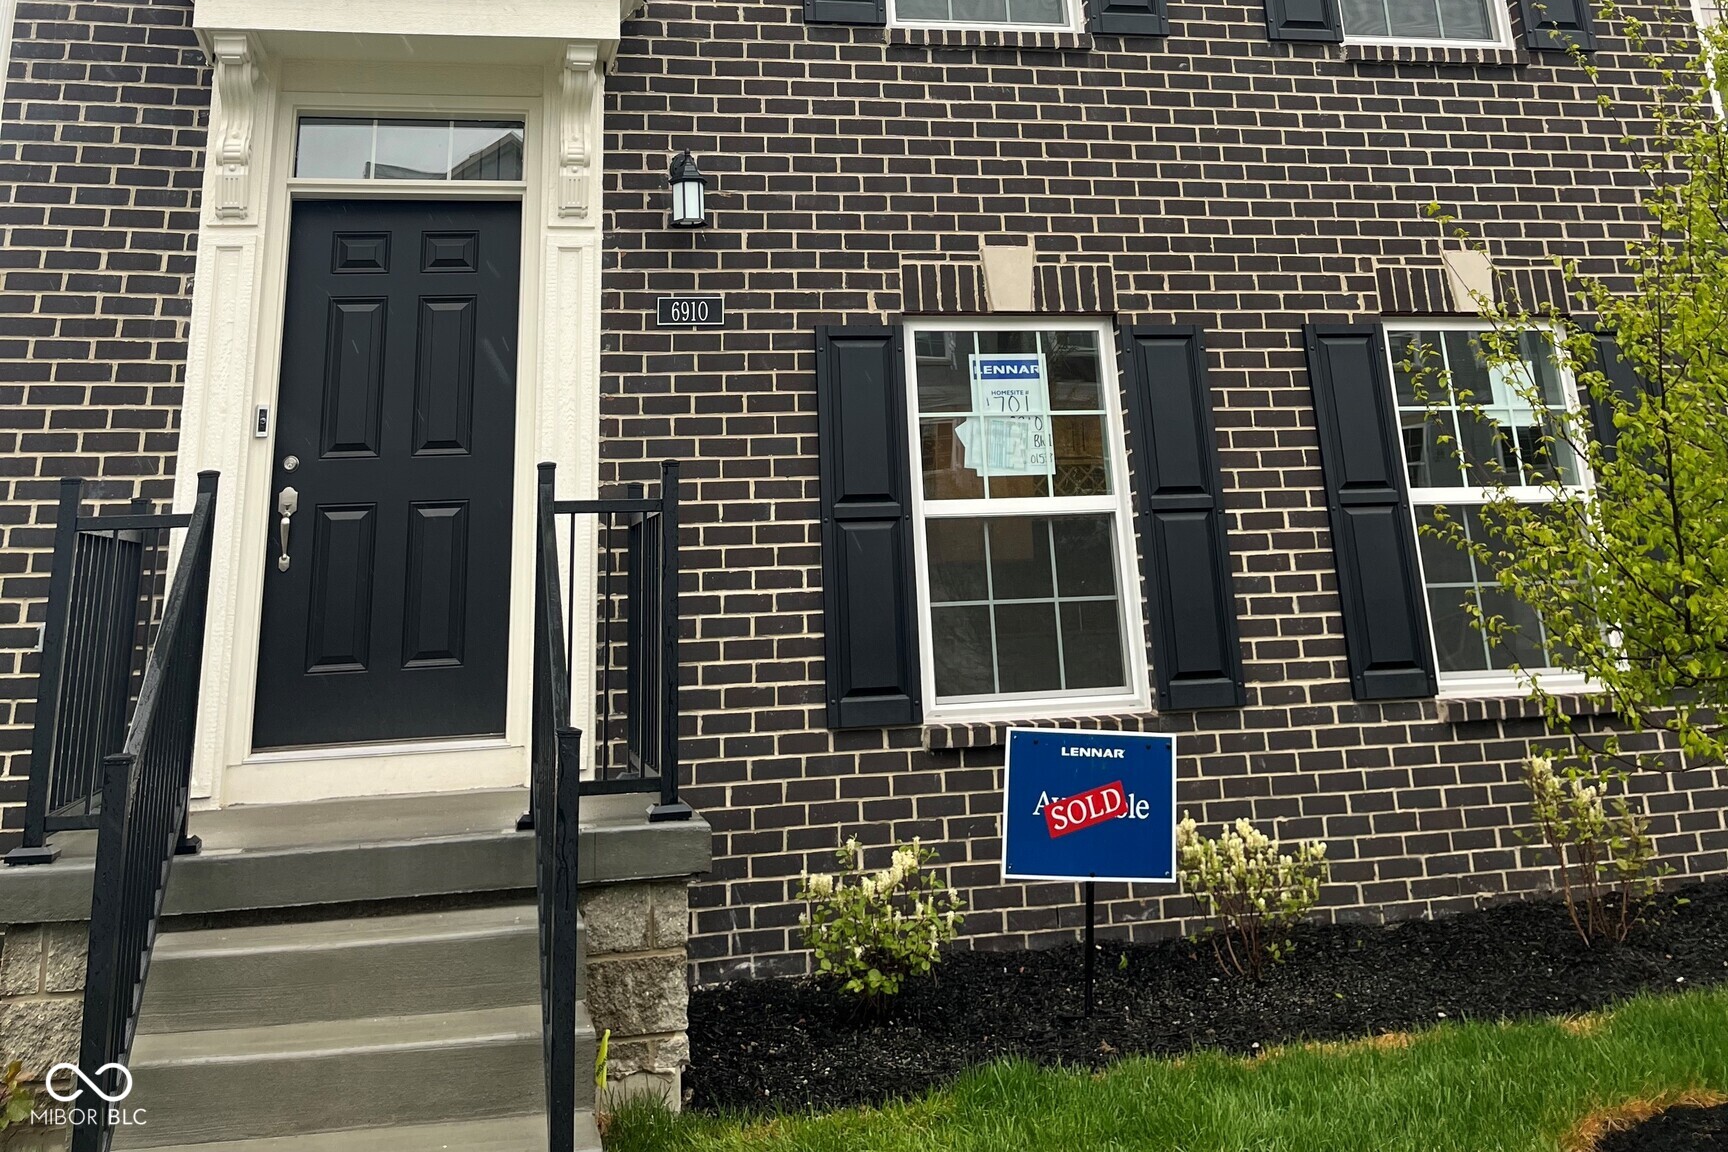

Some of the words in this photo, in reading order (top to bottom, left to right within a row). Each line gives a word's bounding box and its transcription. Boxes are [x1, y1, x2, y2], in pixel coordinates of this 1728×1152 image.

[671, 301, 708, 321] 6910
[1061, 747, 1125, 759] LENNAR
[1051, 788, 1121, 830] SOLD
